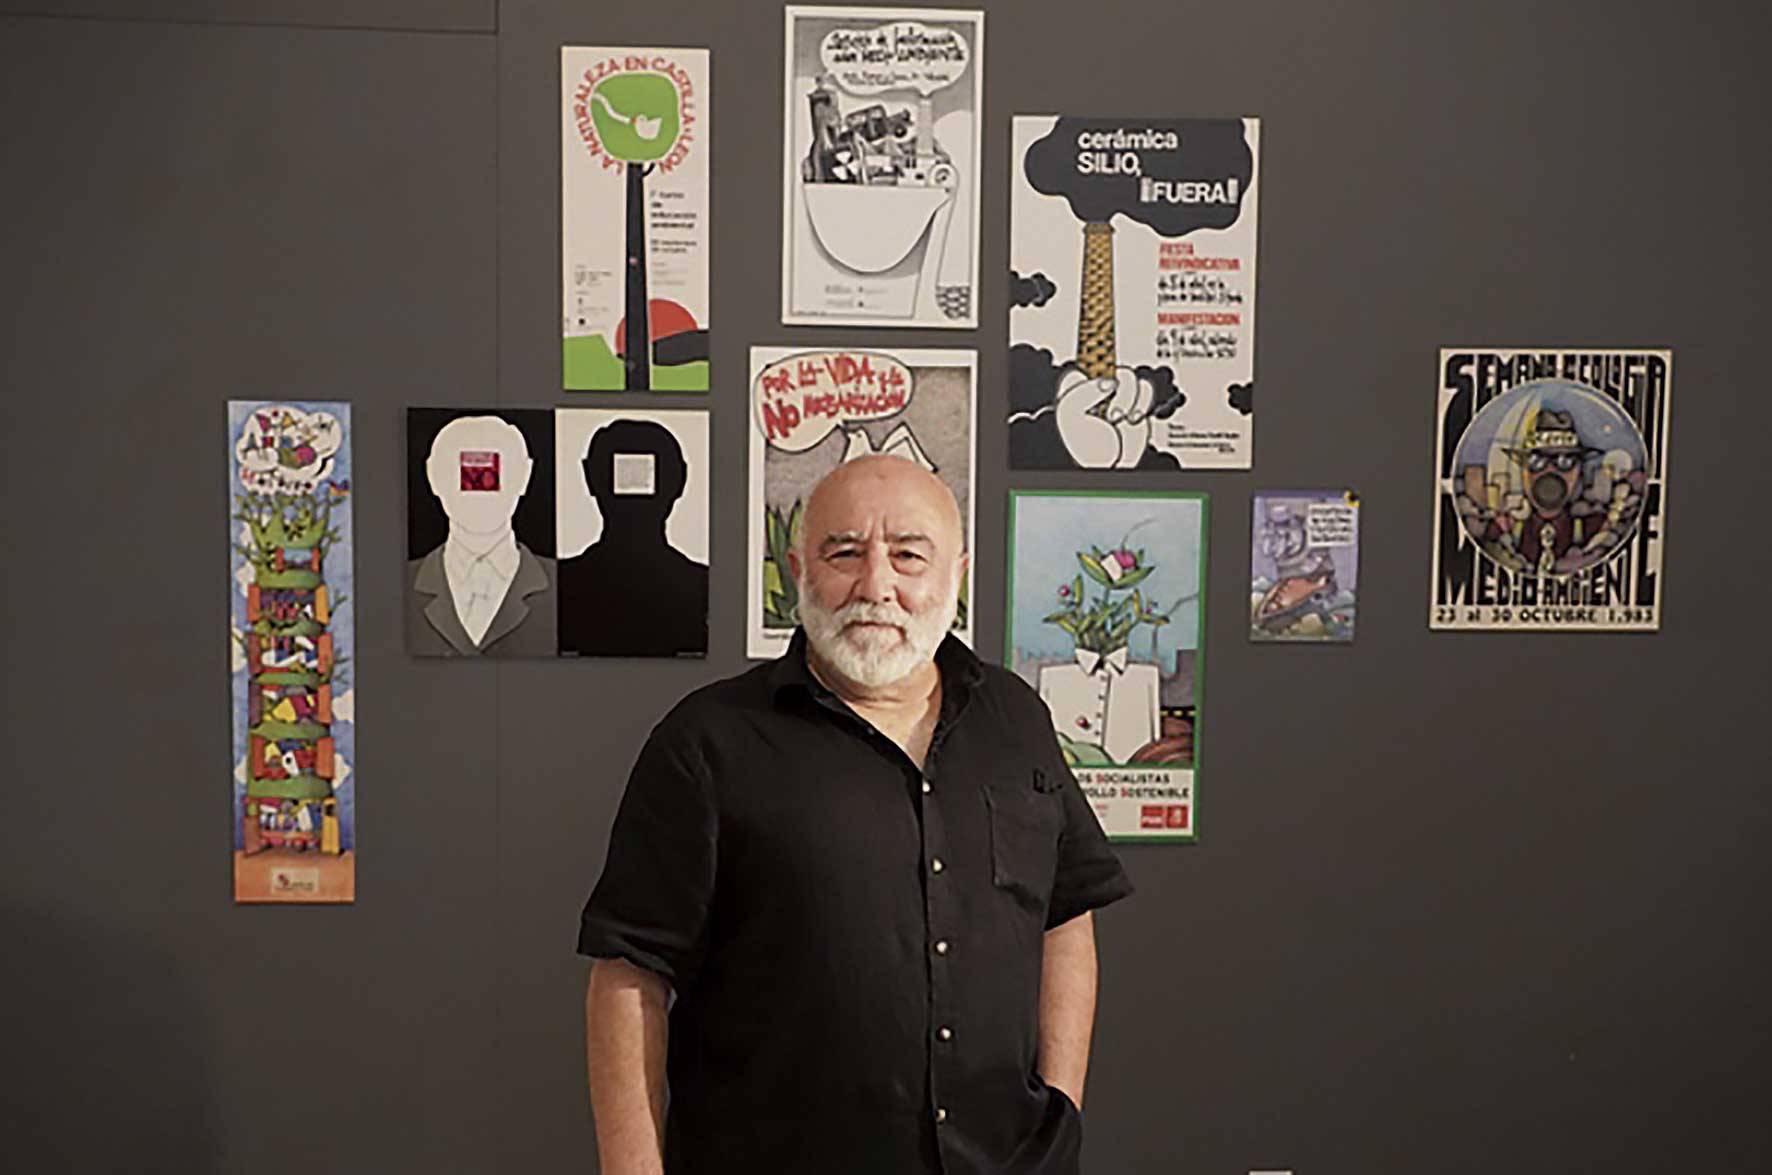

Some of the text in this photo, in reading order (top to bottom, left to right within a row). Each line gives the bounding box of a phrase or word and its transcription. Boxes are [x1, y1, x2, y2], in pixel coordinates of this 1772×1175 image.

[625, 57, 648, 71] EN
[574, 57, 620, 157] NATURALEZA
[1077, 128, 1179, 149] cerámica
[602, 155, 624, 175] LA
[1077, 152, 1142, 176] SILIO,
[762, 367, 797, 399] POR
[823, 352, 876, 388] VIDA
[762, 398, 801, 443] NO
[1437, 608, 1457, 623] 23
[1492, 608, 1513, 623] 30
[1519, 608, 1597, 623] OCTUBRE
[1096, 772, 1170, 784] SOCIALISTAS
[1121, 787, 1189, 799] SOSTENIBLE
